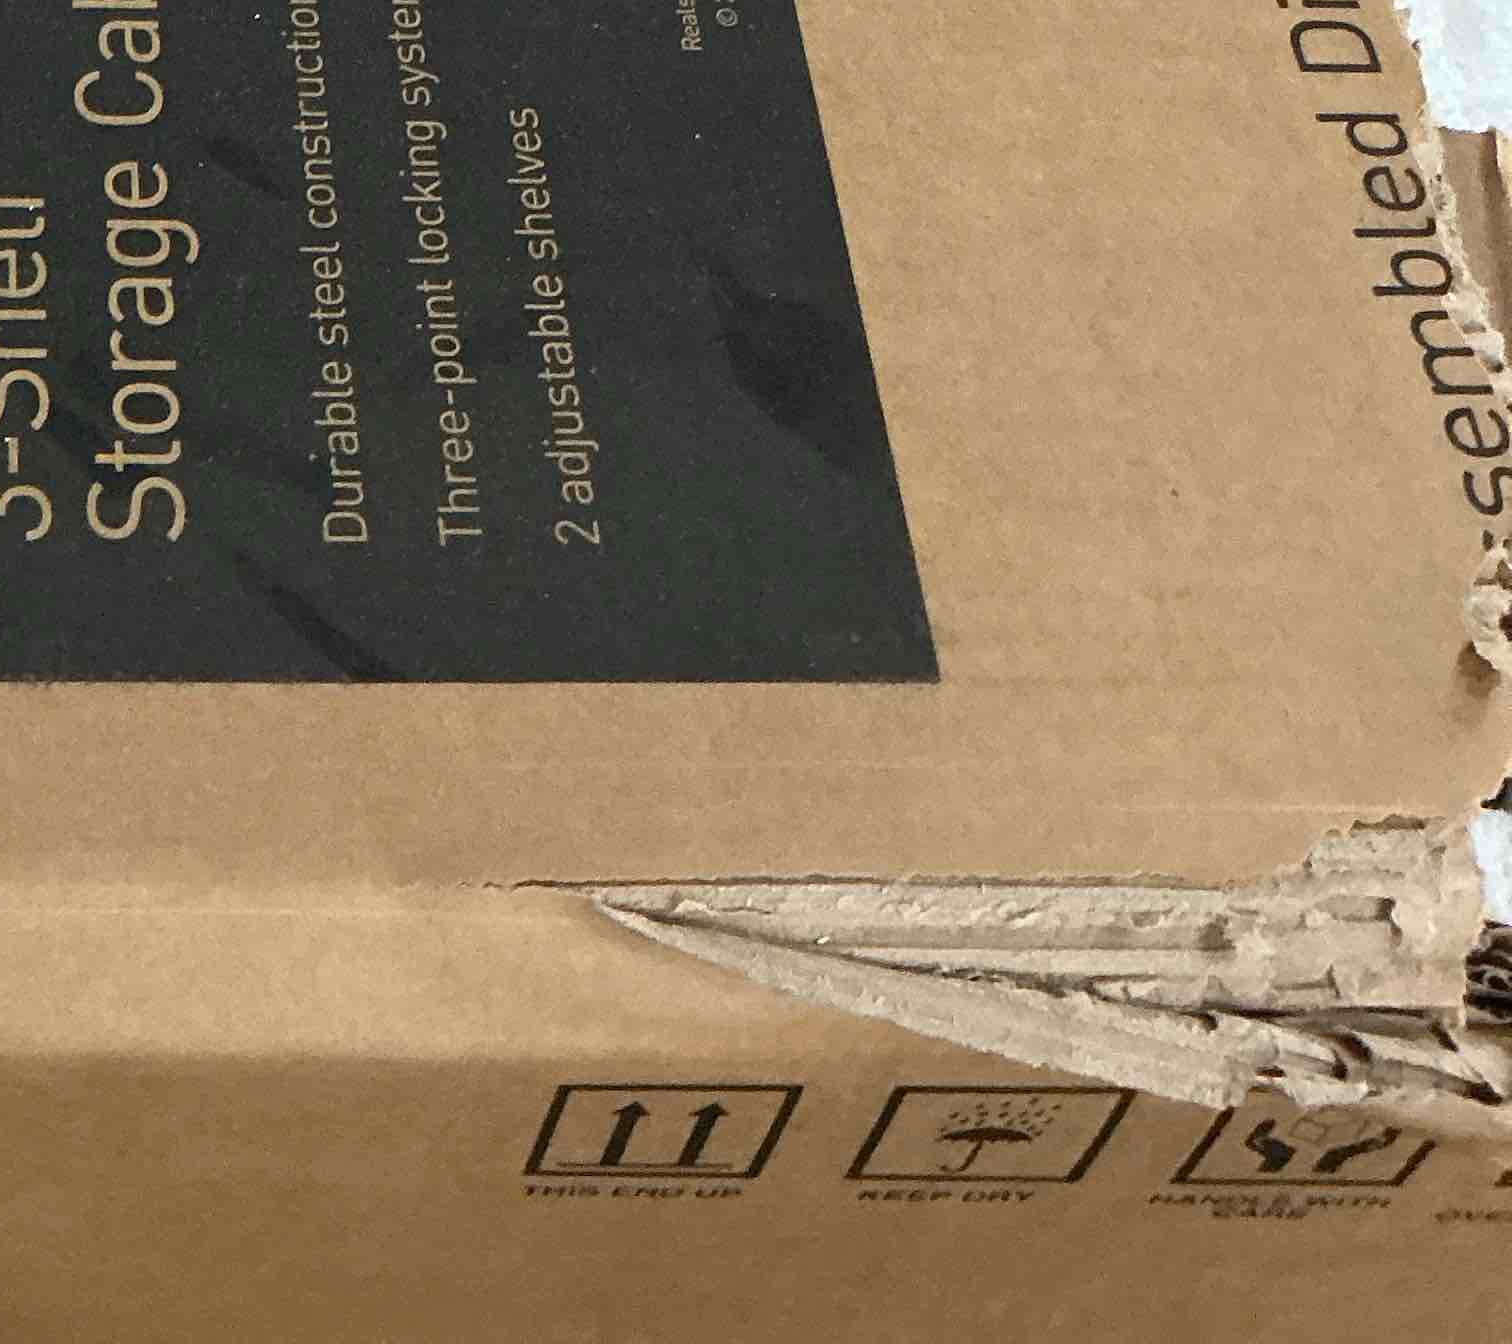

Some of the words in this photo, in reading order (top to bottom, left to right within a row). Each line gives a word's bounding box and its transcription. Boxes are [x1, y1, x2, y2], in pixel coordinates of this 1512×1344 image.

[400, 120, 449, 263] locking
[507, 107, 557, 260] shelves
[88, 162, 199, 542] Storage
[300, 242, 349, 345] steel
[310, 360, 367, 542] Durable
[415, 278, 482, 546] Three-point
[524, 274, 599, 505] adjustable
[555, 520, 600, 544] 2
[524, 1184, 600, 1199] THIS
[611, 1184, 685, 1199] END
[694, 1184, 744, 1199] UP
[856, 1188, 954, 1203] KEEP
[962, 1188, 1035, 1203] DRY
